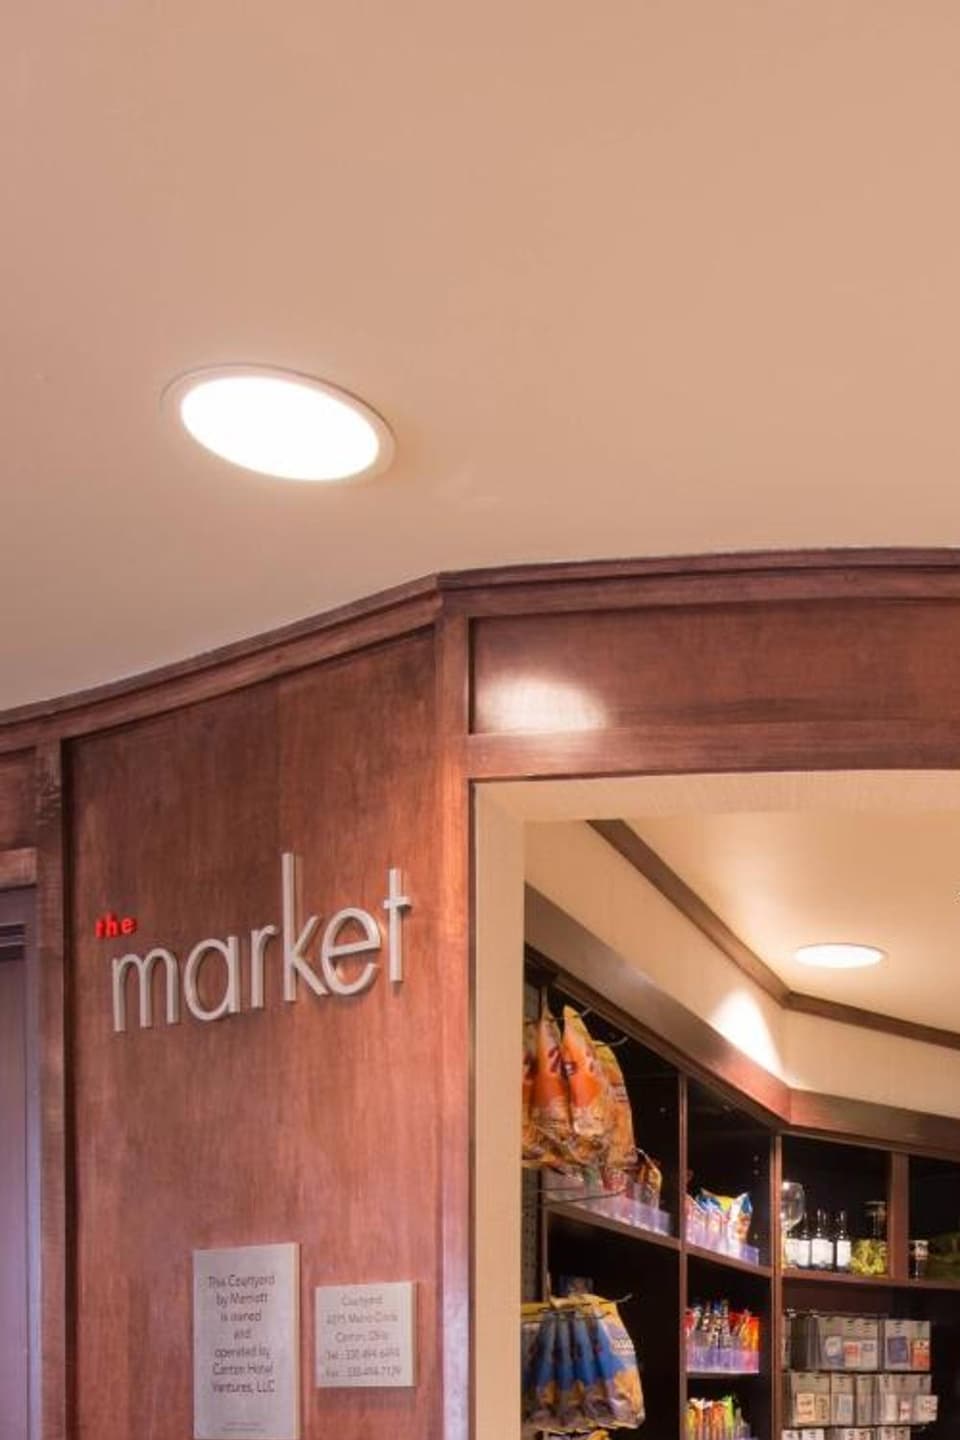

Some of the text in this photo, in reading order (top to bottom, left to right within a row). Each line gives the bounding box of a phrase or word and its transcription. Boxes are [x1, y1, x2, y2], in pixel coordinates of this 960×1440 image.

[95, 912, 137, 938] the
[111, 852, 413, 1032] market
[228, 1274, 276, 1290] Courtyard
